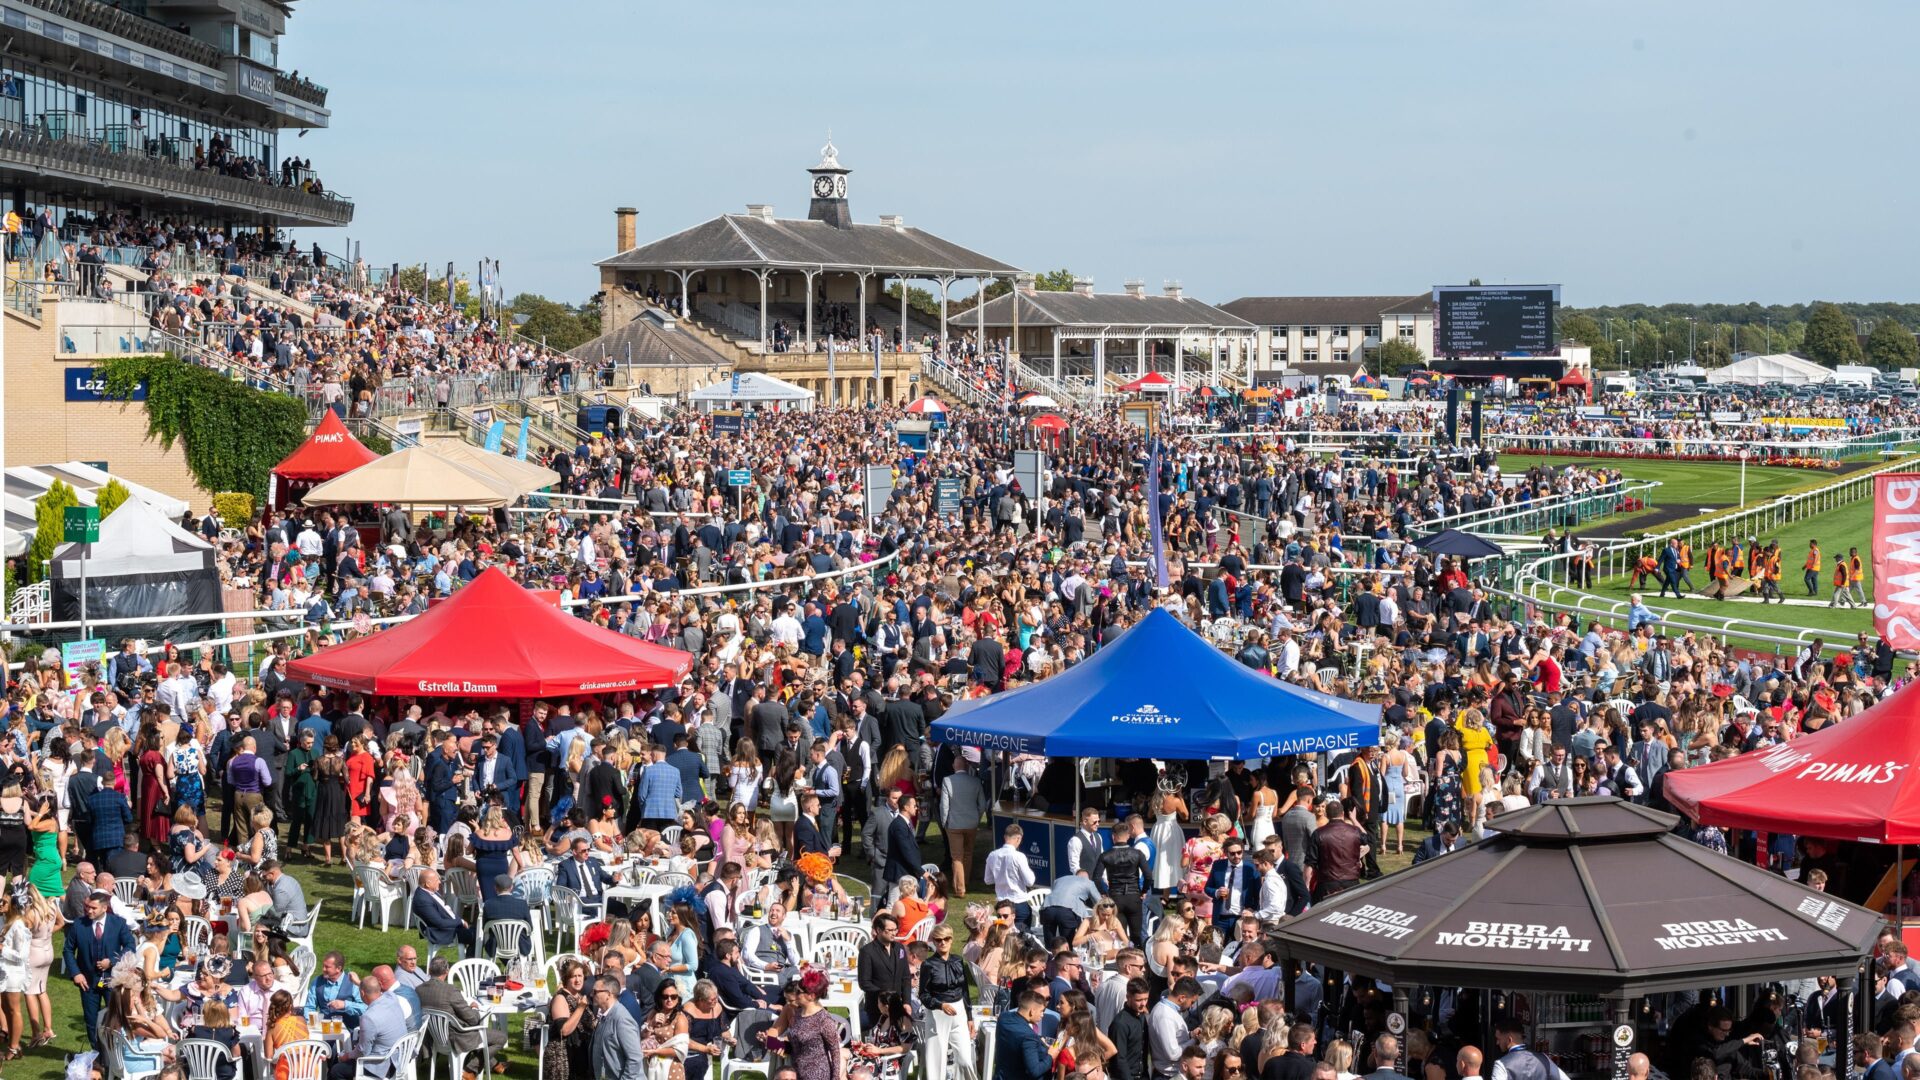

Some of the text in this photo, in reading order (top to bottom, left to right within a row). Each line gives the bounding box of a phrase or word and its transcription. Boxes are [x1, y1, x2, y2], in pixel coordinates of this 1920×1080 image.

[249, 69, 272, 96] Lazarus
[76, 377, 142, 391] Lazs
[1790, 418, 1843, 427] DONCASTER
[314, 432, 344, 444] PIMM'S
[418, 680, 498, 693] Estrella Damm
[580, 679, 637, 691] drinkaware.co.uk
[1111, 715, 1181, 724] POMMERY
[945, 727, 1029, 752] CHAMPAGNE
[1257, 732, 1359, 757] CHAMPAGNE
[1796, 761, 1909, 784] PIMM'S
[1351, 904, 1418, 927] BIRRA
[1319, 911, 1415, 940] MORETTI
[1465, 921, 1571, 938] BIRRA
[1661, 918, 1758, 936] BIRRA
[1435, 932, 1592, 952] MORETTI
[1654, 928, 1789, 950] MORETTI
